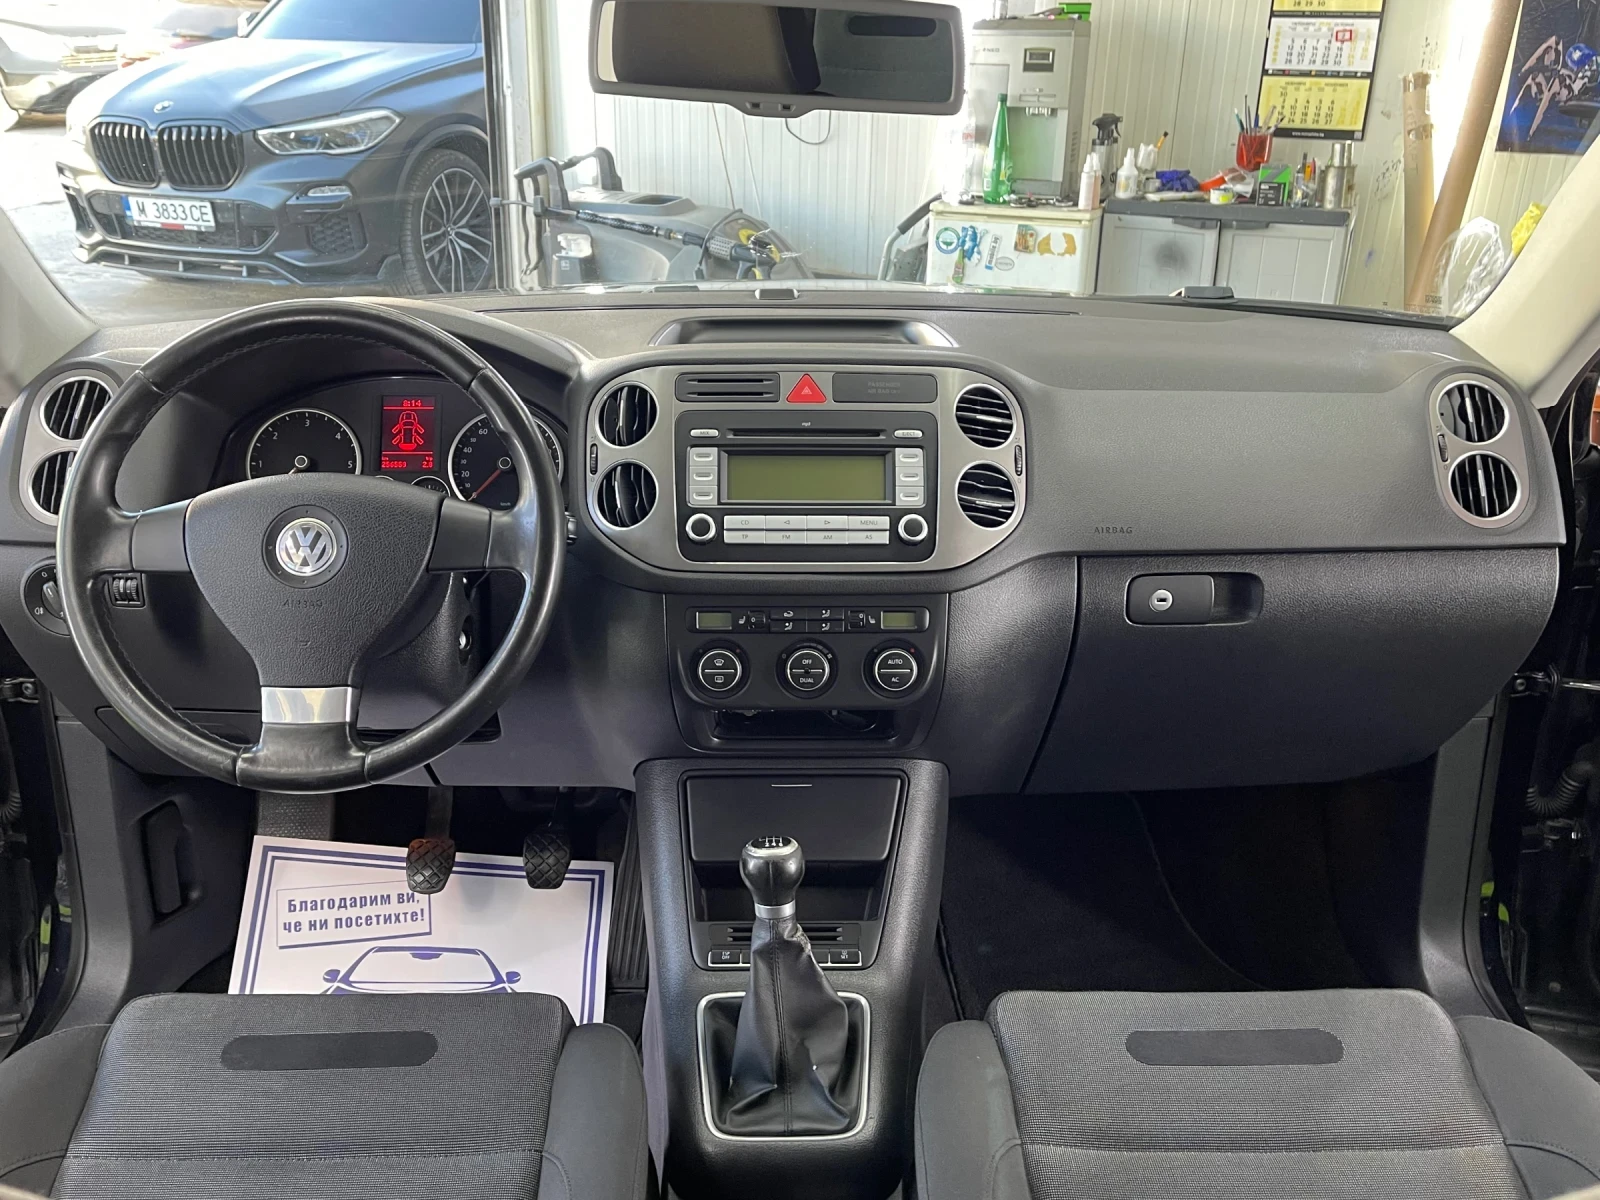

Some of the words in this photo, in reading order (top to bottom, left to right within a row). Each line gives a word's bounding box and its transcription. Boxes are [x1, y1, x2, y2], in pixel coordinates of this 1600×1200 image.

[272, 432, 278, 440] 2
[335, 432, 342, 440] 4
[347, 460, 353, 468] 5
[288, 892, 391, 913] Благодарим
[397, 892, 420, 904] ви,
[283, 920, 302, 933] че
[308, 918, 328, 931] ни
[334, 908, 424, 929] посетихте!
